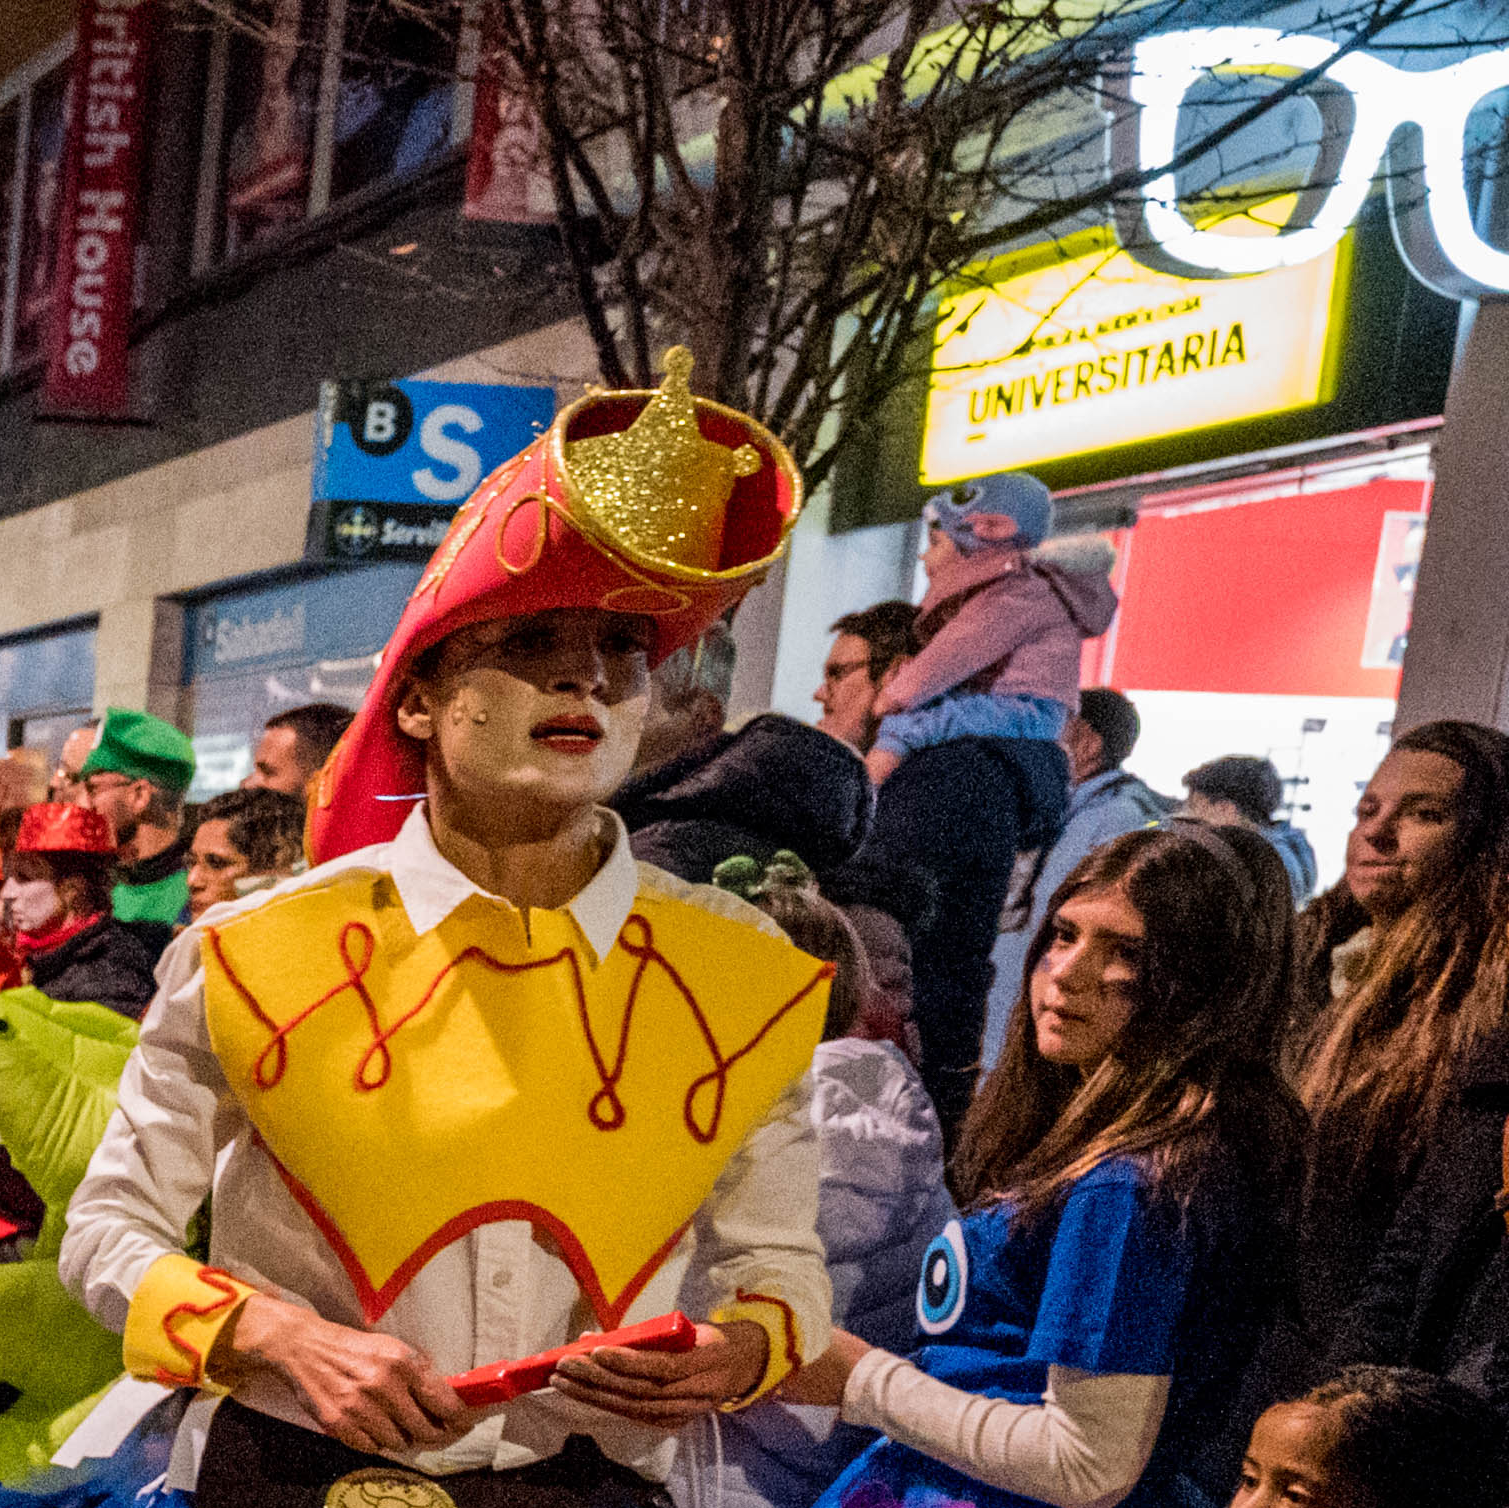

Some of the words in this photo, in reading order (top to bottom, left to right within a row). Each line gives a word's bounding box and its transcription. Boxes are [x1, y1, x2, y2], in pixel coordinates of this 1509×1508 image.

[66, 190, 126, 376] House
[968, 322, 1247, 425] UNIVERSITARIA
[363, 401, 398, 443] B
[411, 403, 485, 501] S
